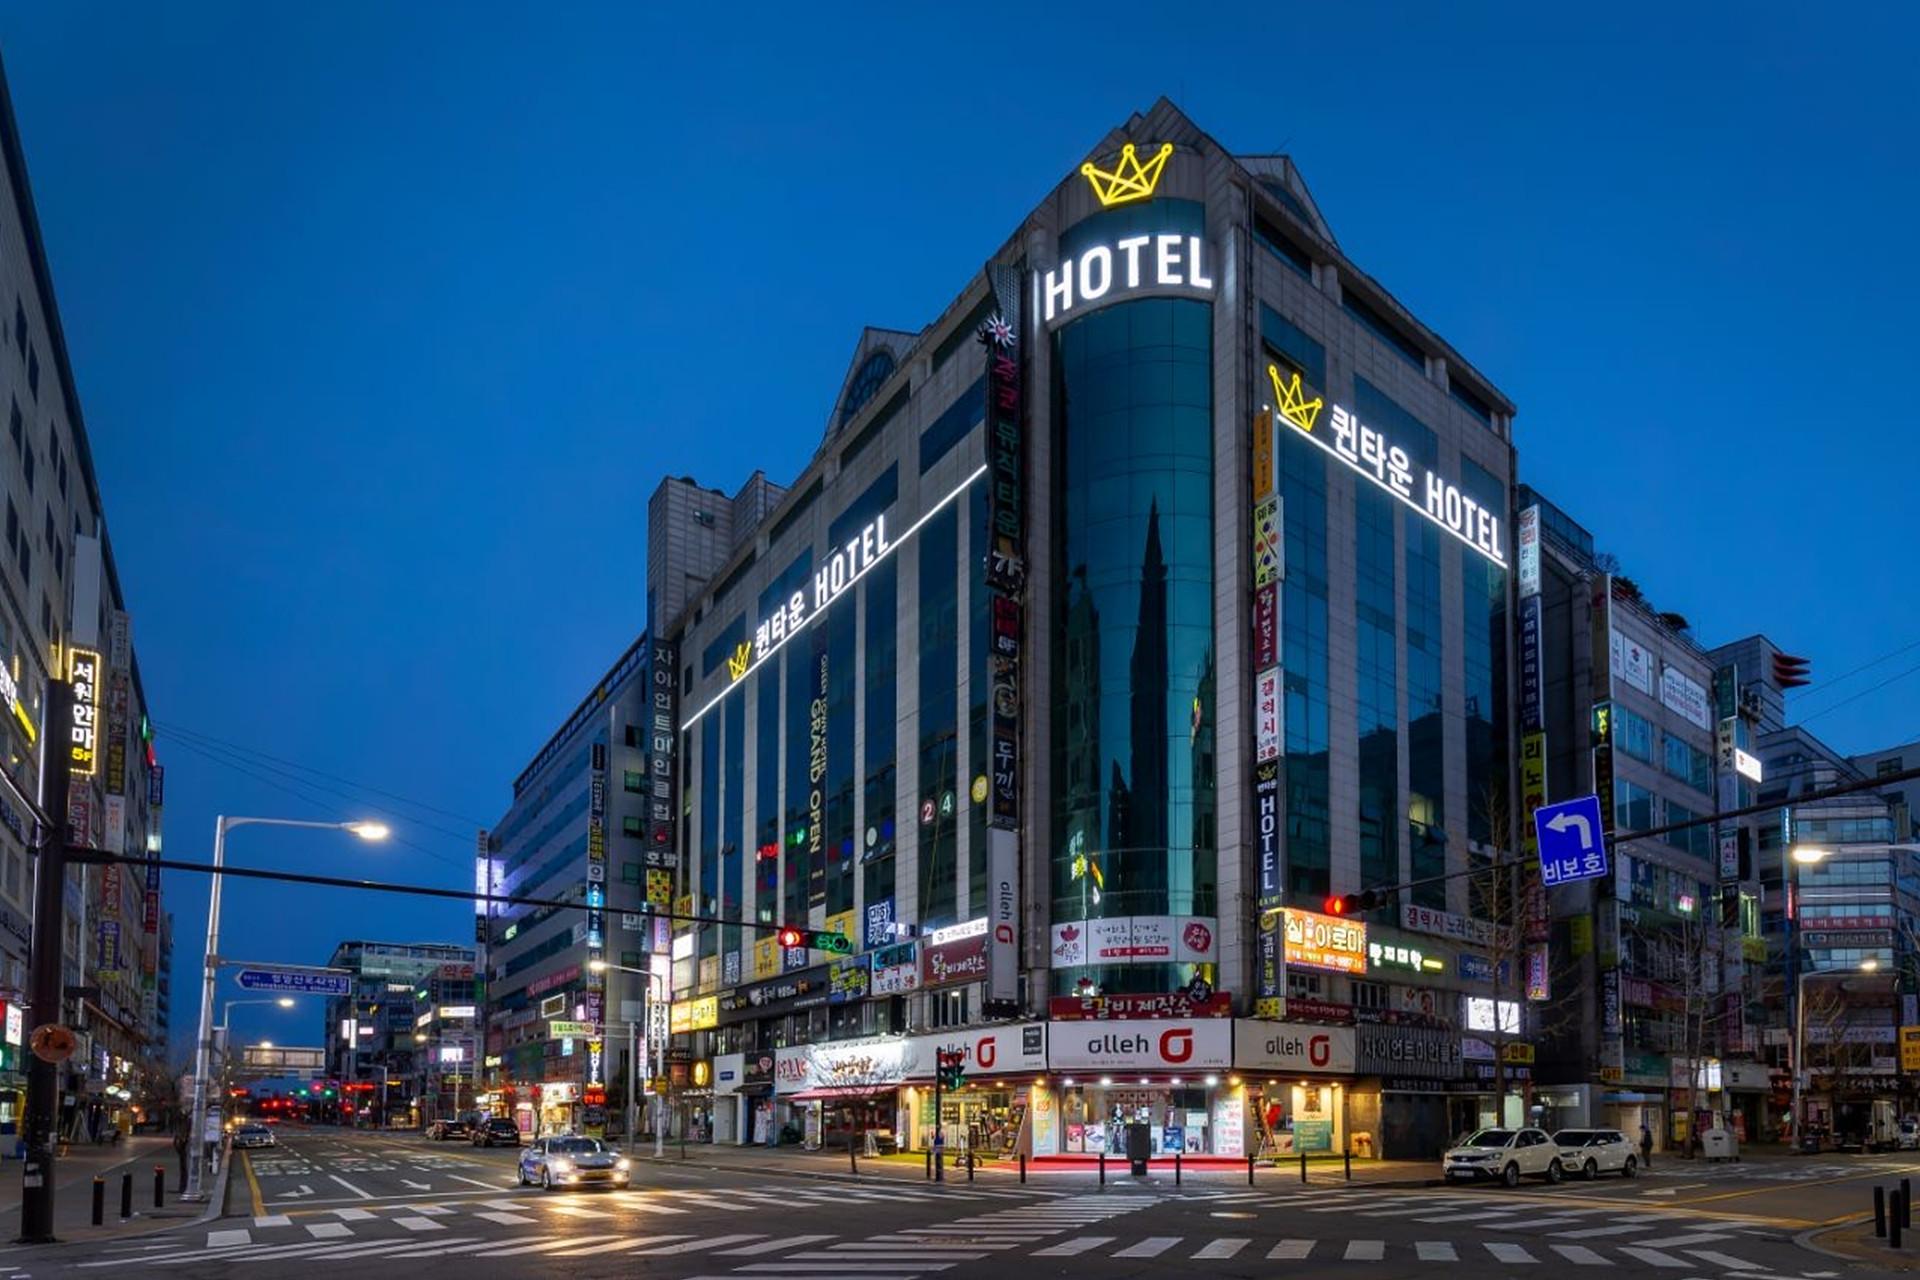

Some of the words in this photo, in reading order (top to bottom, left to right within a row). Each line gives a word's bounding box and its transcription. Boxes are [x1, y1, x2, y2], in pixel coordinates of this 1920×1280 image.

[1045, 234, 1212, 321] HOTEL
[1330, 404, 1413, 497] 퀸타운
[1426, 470, 1504, 561] HOTEL
[755, 591, 805, 660] 퀸타운
[815, 514, 889, 609] HOTEL
[72, 662, 94, 748] 서원안마
[72, 747, 93, 761] 5F
[810, 698, 826, 783] GRAND
[995, 741, 1015, 788] 두끼
[810, 790, 822, 853] OPEN
[1261, 795, 1275, 889] HOTEL
[1543, 853, 1604, 881] 비보호
[1001, 881, 1014, 921] olleh
[1316, 923, 1363, 953] 아로마
[1088, 1034, 1149, 1054] olleh
[1266, 1036, 1304, 1055] olleh
